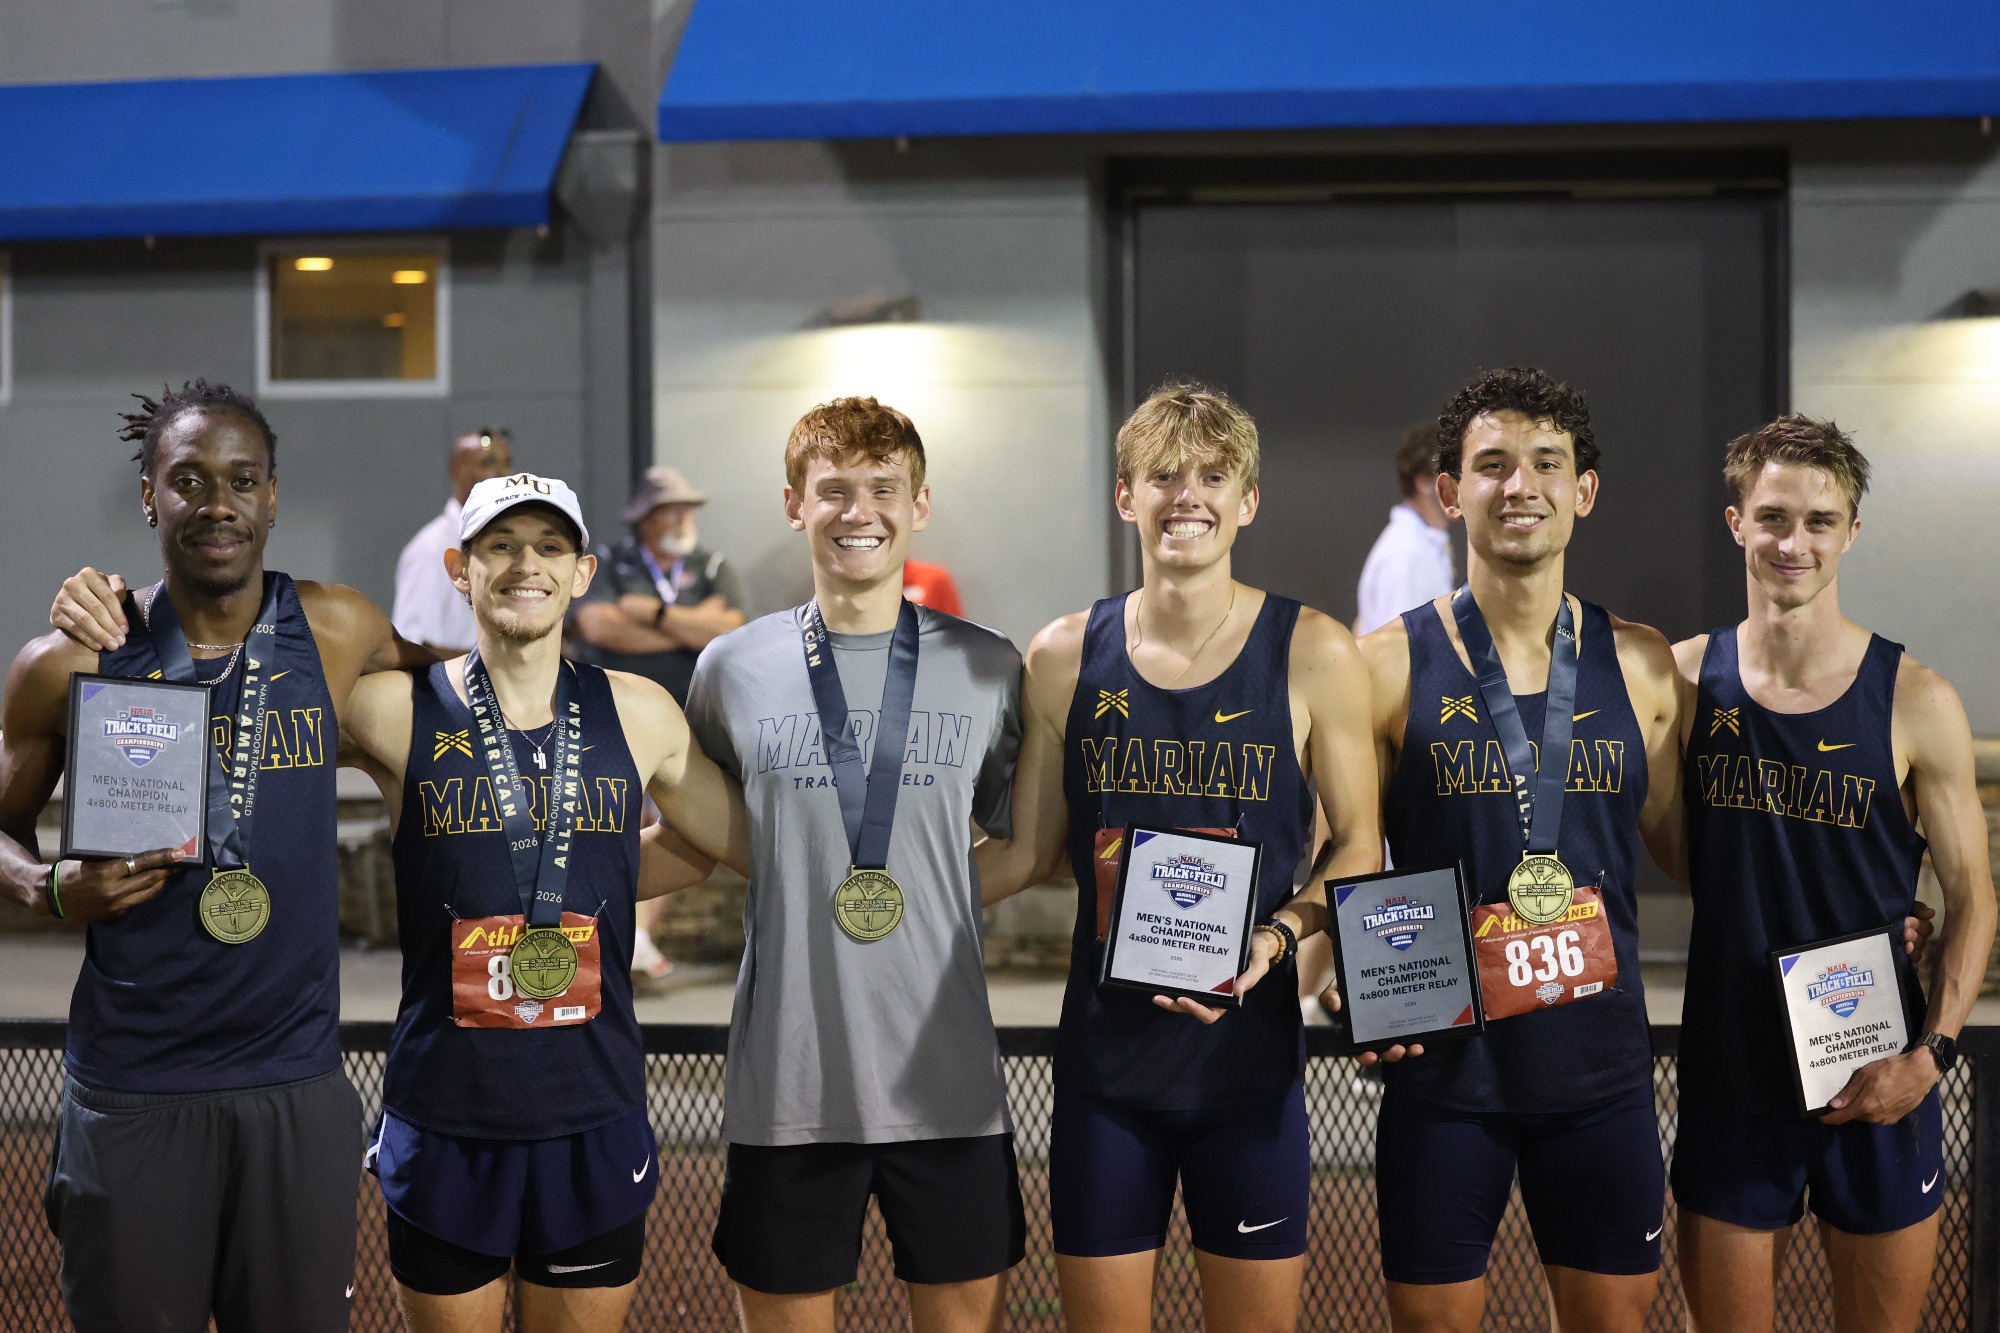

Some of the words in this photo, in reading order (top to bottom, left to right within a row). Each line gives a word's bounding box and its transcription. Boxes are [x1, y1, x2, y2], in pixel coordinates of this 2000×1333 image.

[502, 474, 550, 495] MU
[258, 684, 268, 706] NAIA
[252, 708, 264, 754] OUTDOOR
[480, 674, 491, 694] NAIA
[486, 693, 504, 737] OUTDOOR
[500, 736, 512, 761] TRACK
[509, 768, 520, 791] FIELD
[230, 658, 260, 831] ALL-AMERICA
[249, 756, 259, 784] TRACK
[555, 748, 565, 773] TRACK
[1082, 737, 1275, 800] MARIAN
[93, 775, 128, 786] MEN'S
[132, 778, 185, 791] NATIONAL
[554, 702, 581, 869] ALL-AMERICAN
[794, 776, 837, 790] TRAC
[1698, 754, 1876, 829] MARIAN
[108, 788, 168, 801] CHAMPION
[244, 792, 255, 816] FIELD
[551, 774, 562, 821] OUTDOOR
[86, 798, 117, 808] 4x800
[121, 801, 154, 812] METER
[158, 804, 188, 814] RELAY
[547, 822, 557, 842] NAIA
[511, 836, 538, 851] 2026
[1180, 856, 1202, 866] NAIA
[536, 890, 562, 904] 2026
[1571, 906, 1596, 917] NET
[1136, 912, 1172, 926] MEN'S
[1175, 918, 1228, 934] NATIONAL
[1150, 925, 1210, 942] CHAMPION
[1128, 933, 1159, 944] 4x800
[1162, 938, 1196, 951] METER
[1198, 944, 1229, 956] RELAY
[1361, 965, 1396, 978] MEN'S
[1398, 956, 1451, 972] NATIONAL
[1505, 930, 1585, 987] 836
[1827, 964, 1848, 974] NAIA
[1378, 969, 1437, 986] CHAMPION
[1360, 989, 1389, 1000] 4x800
[1392, 983, 1425, 995] METER
[1428, 978, 1458, 990] RELAY
[1809, 1032, 1841, 1047] MEN'S
[1844, 1020, 1891, 1038] NATIONAL
[1826, 1034, 1879, 1053] CHAMPION
[1810, 1056, 1836, 1068] 4x800
[1839, 1049, 1869, 1062] METER
[1872, 1041, 1898, 1054] RELAY
